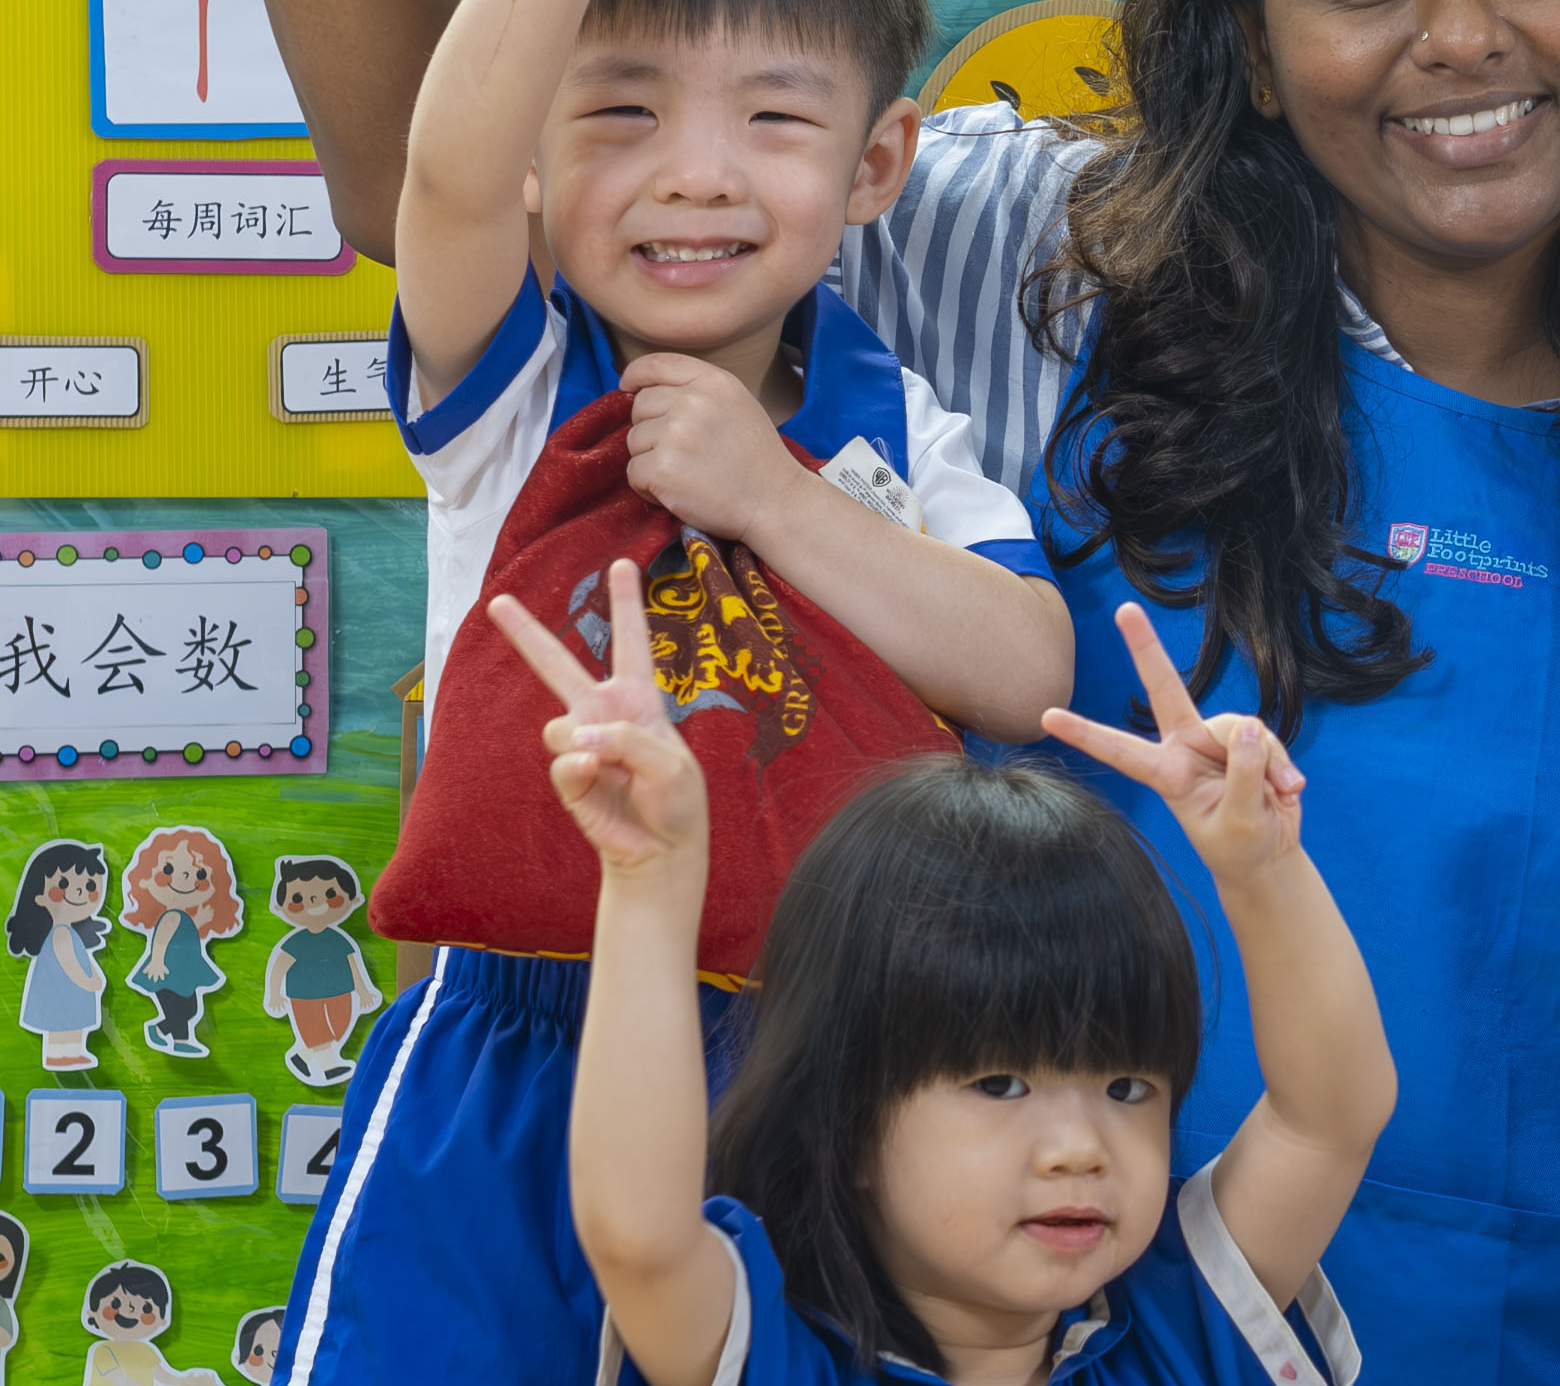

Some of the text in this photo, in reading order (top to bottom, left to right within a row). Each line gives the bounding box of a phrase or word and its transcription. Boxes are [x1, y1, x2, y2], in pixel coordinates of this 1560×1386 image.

[142, 199, 313, 240] 每周词汇
[20, 366, 102, 403] 开心
[1430, 528, 1492, 553] Little
[1427, 543, 1549, 579] Footprints
[52, 1111, 96, 1176] 2
[184, 1117, 229, 1181] 3
